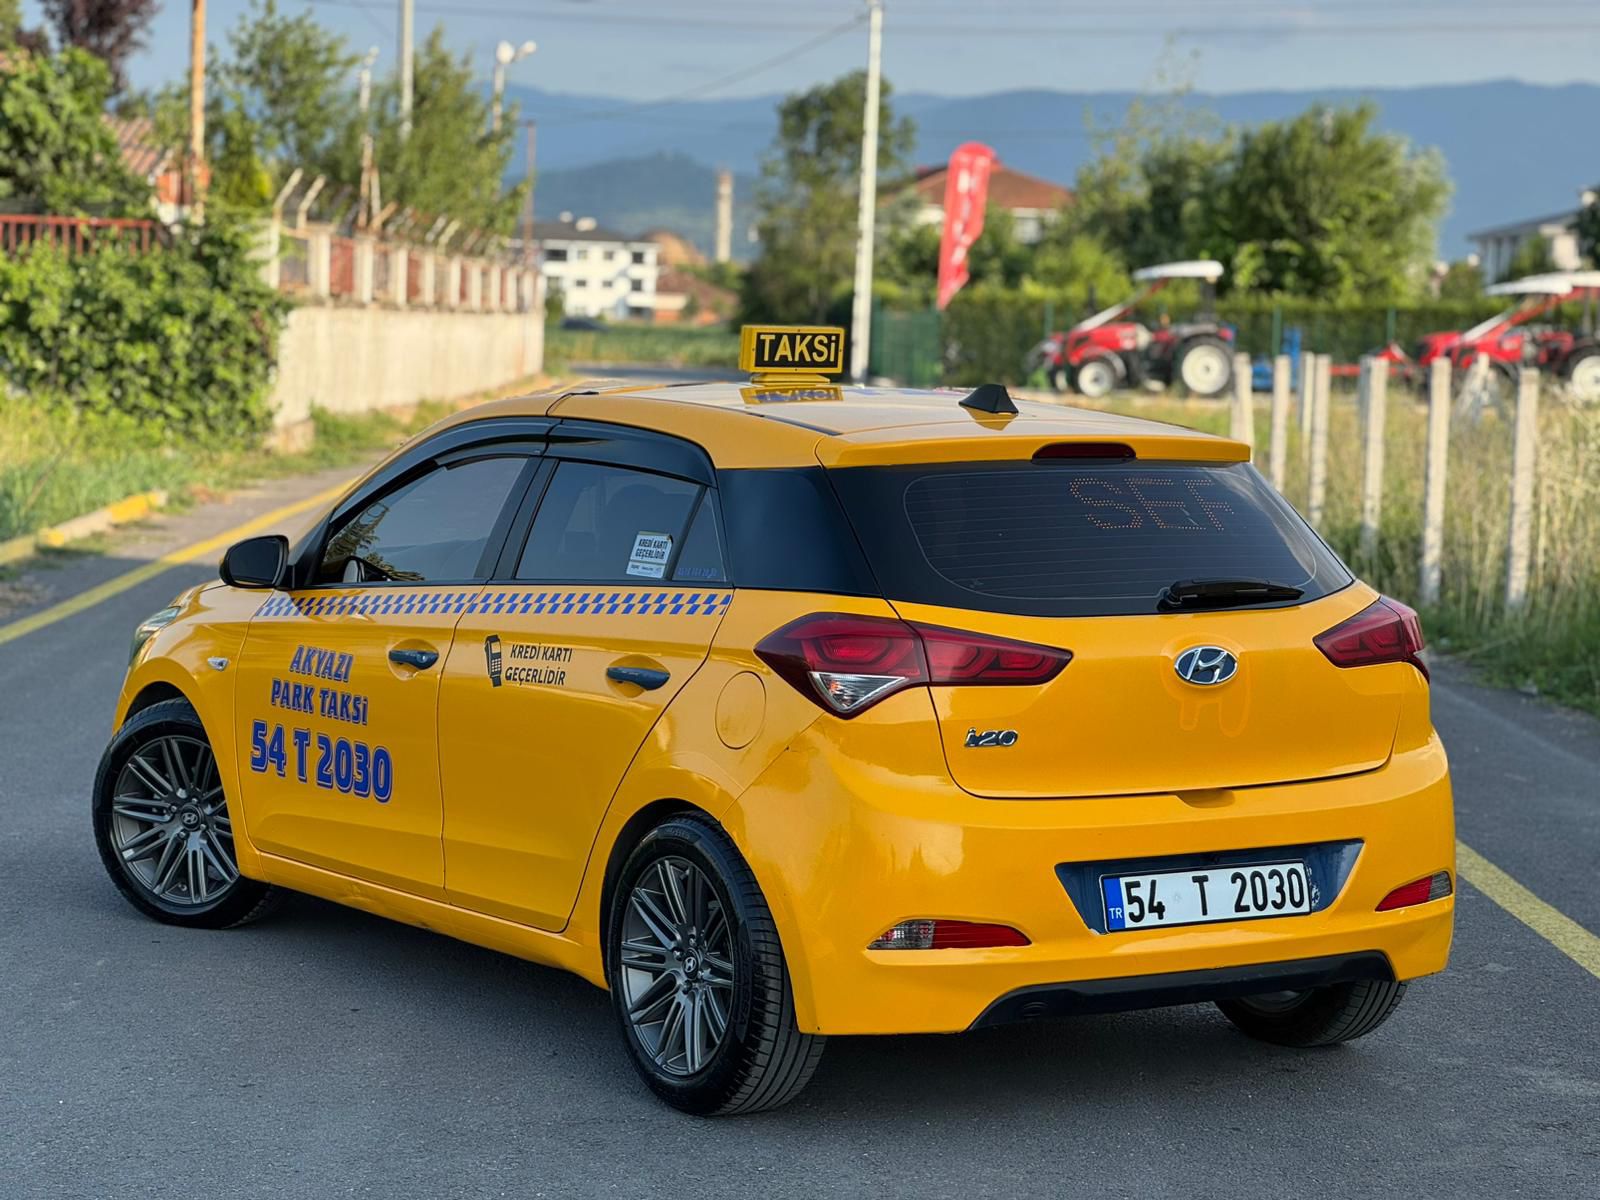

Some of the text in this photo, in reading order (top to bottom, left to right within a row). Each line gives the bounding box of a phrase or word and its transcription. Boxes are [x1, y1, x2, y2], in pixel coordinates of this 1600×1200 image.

[289, 644, 353, 682] AKYAZI
[510, 643, 573, 663] KREDİ KARTI
[505, 665, 566, 686] GEÇERLİDİR
[271, 678, 315, 713] PARK
[964, 727, 1018, 748] i20
[250, 719, 393, 804] 54 T 2030
[1124, 867, 1305, 924] 54 T 2030
[1109, 907, 1123, 920] TR
